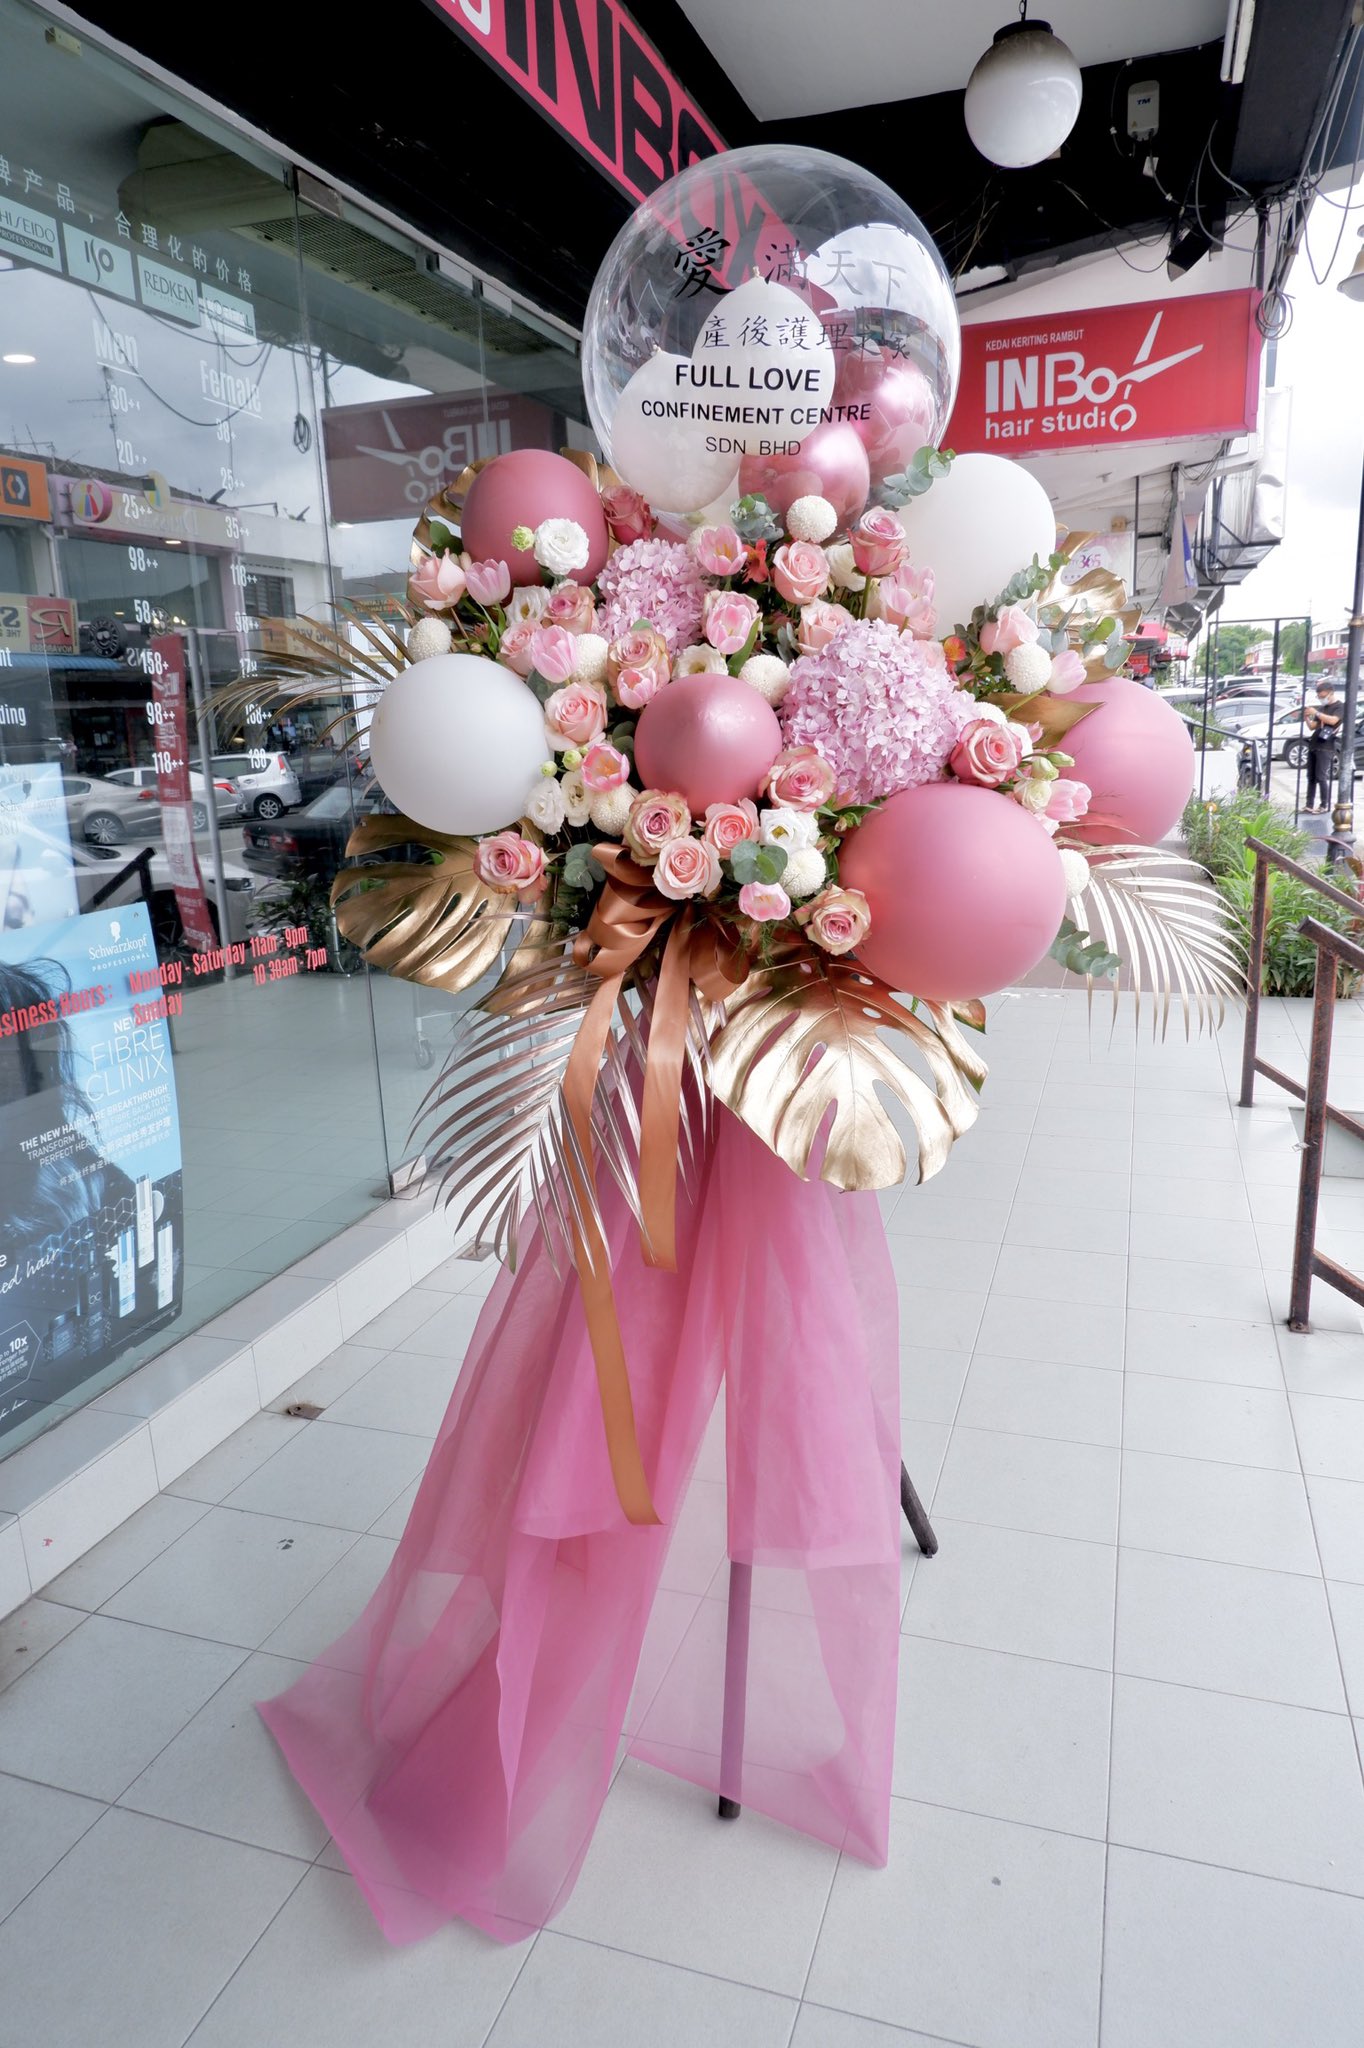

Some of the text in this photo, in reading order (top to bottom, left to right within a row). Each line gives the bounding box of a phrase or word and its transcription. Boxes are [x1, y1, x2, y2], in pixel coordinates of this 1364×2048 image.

[144, 270, 195, 305] REDKEN
[92, 317, 138, 368] Men
[985, 329, 1084, 352] KEDAI KERITING RAMBUT
[200, 359, 262, 412] Female
[675, 364, 821, 392] FULL LOVE
[641, 400, 872, 425] CONFINEMENT CENTRE
[985, 417, 1034, 440] hair
[705, 436, 802, 456] SDN BHD
[128, 546, 159, 572] 98++
[133, 599, 164, 624] 58++
[146, 701, 176, 725] 98++
[152, 752, 184, 775] 118++
[89, 933, 147, 961] Schwarzkopf
[128, 960, 182, 995] Monday
[192, 941, 246, 975] Saturday
[250, 934, 277, 959] 11am
[285, 925, 309, 949] 9pm
[131, 992, 183, 1026] Sunday
[305, 947, 327, 972] 7pm
[91, 1022, 165, 1071] FIBRE
[86, 1049, 168, 1101] CLINIX
[20, 1085, 168, 1152] THE NEW HAIR CARE BREAKTHROUGH
[27, 1135, 76, 1161] TRANSFORM
[39, 1147, 75, 1167] PERFECT
[9, 1335, 28, 1353] 10x
